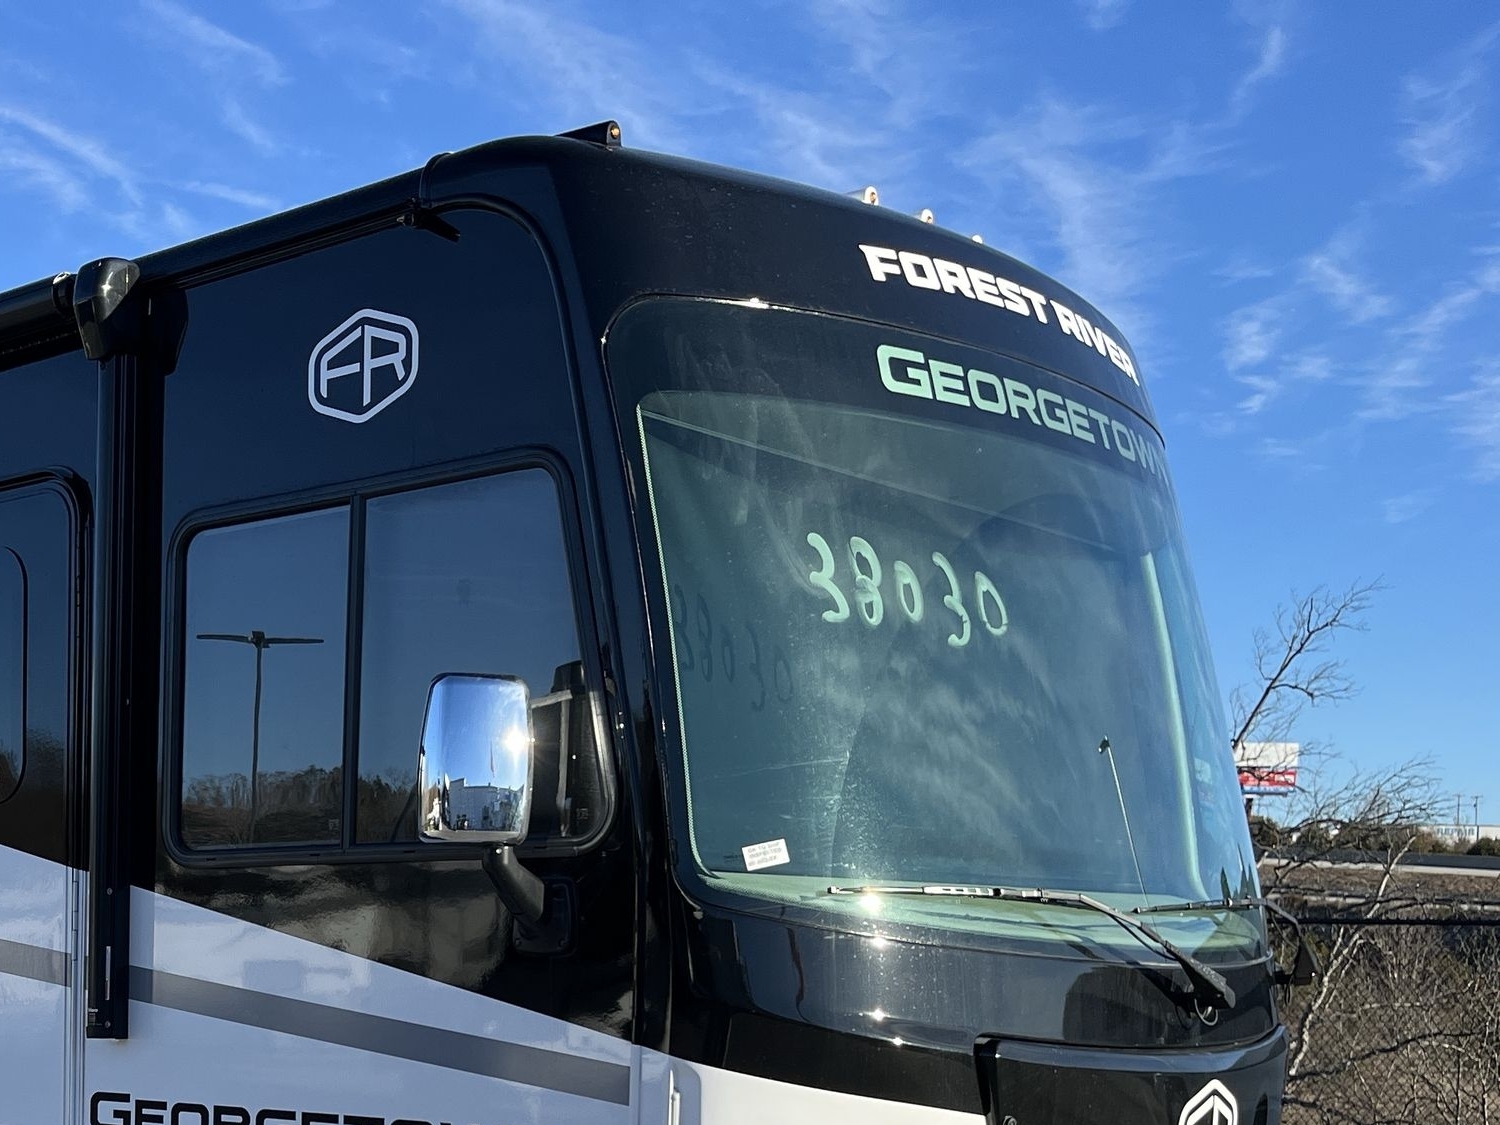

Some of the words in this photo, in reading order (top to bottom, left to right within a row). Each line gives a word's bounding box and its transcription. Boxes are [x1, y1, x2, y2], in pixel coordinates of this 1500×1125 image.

[859, 245, 1048, 324] FOREST
[1050, 299, 1140, 386] RIVER
[877, 344, 1172, 492] GEORGETOWN
[807, 532, 1008, 647] 38030
[1437, 828, 1475, 836] REPAIR
